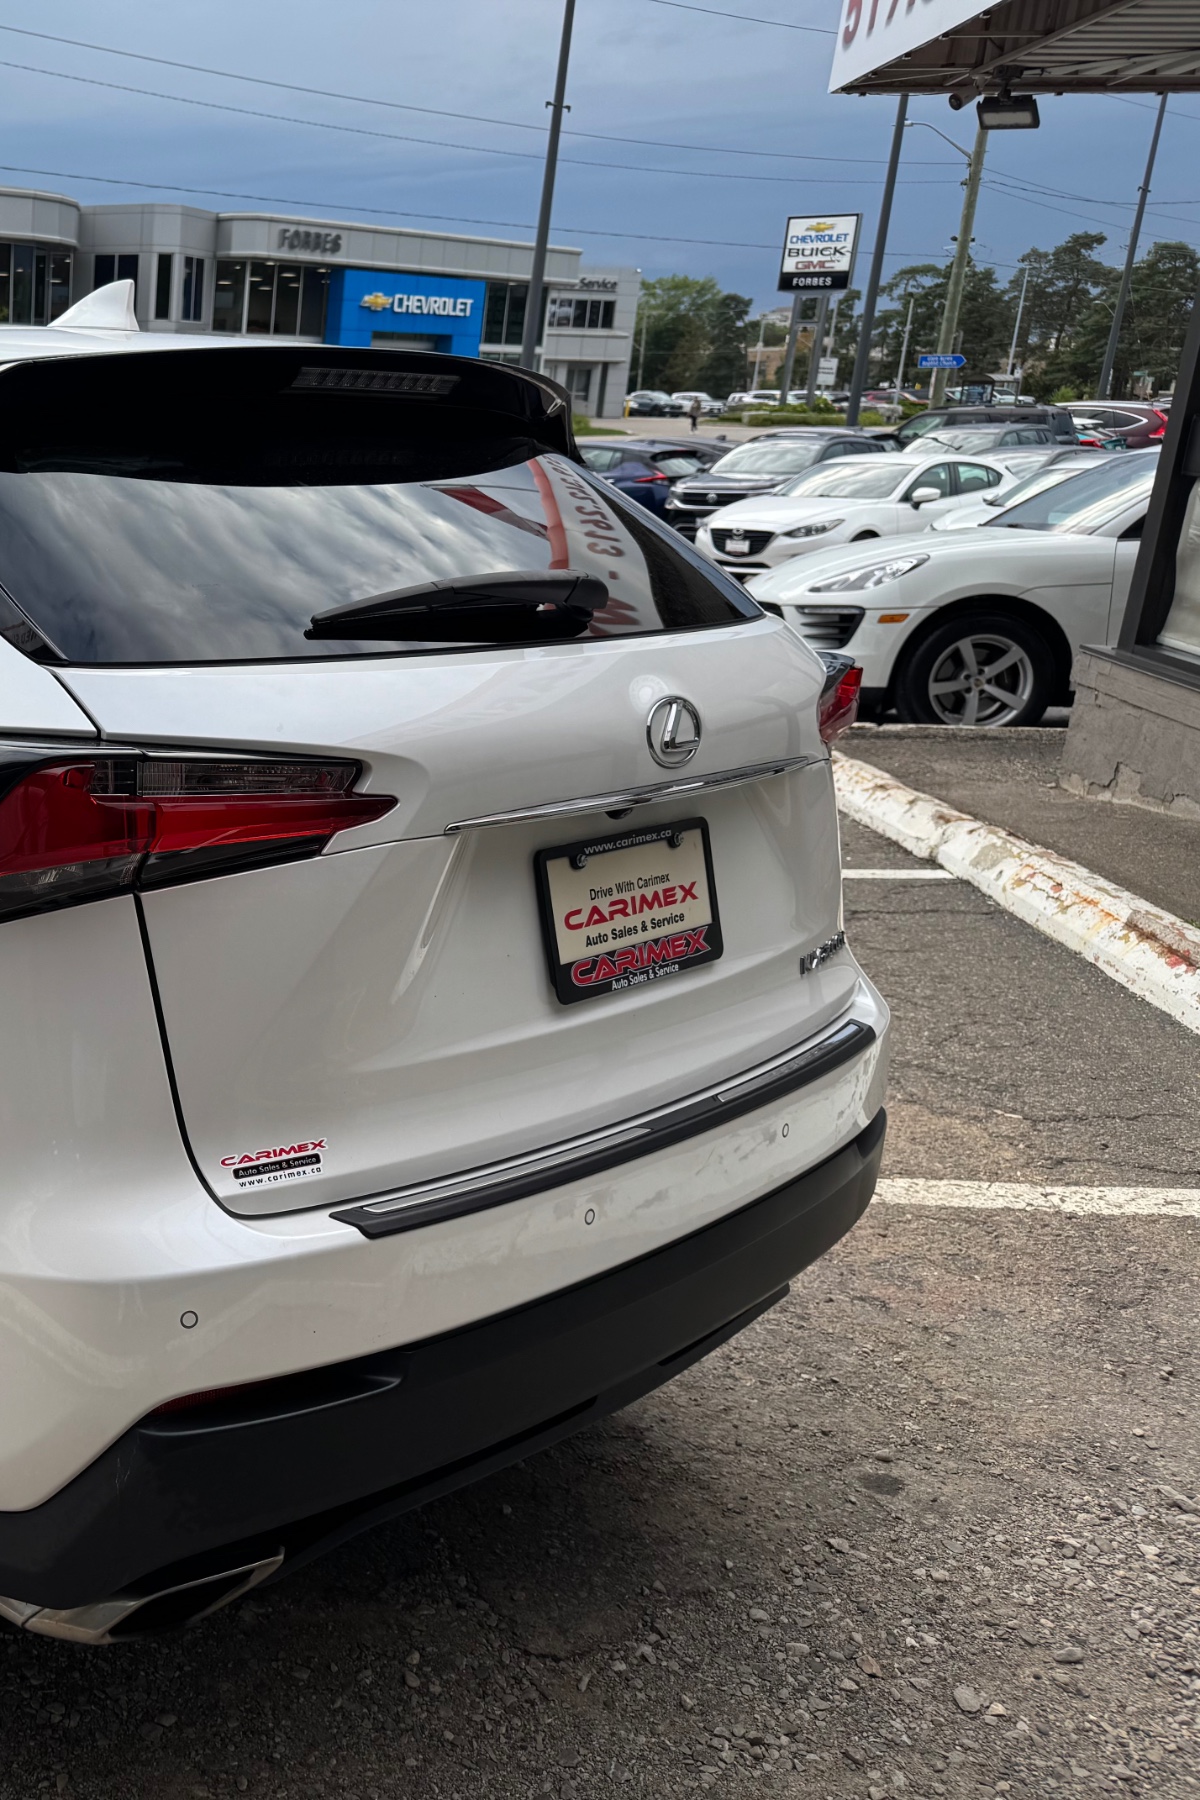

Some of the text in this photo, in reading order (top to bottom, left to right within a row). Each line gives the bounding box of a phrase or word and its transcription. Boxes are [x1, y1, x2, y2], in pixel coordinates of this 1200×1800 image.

[278, 229, 342, 254] FORBES
[790, 233, 849, 244] CHEVROLET
[788, 246, 847, 257] BUICK
[795, 260, 836, 270] GMC
[579, 277, 617, 290] Service
[792, 277, 832, 286] FORBES
[393, 294, 474, 316] CHEVROLET
[584, 830, 672, 854] www.carimex.ca
[590, 873, 670, 901] Drive With Carimex
[564, 881, 698, 931] CARIMEX
[586, 912, 685, 947] Auto Sales & Service
[571, 926, 710, 986] CARIMEX
[612, 963, 679, 991] Auto Sales & Service
[221, 1139, 326, 1167] CARIMEX
[238, 1168, 257, 1177] Auto
[260, 1164, 280, 1173] Sales
[290, 1157, 316, 1167] Service
[239, 1167, 322, 1188] www.carimex.ca
